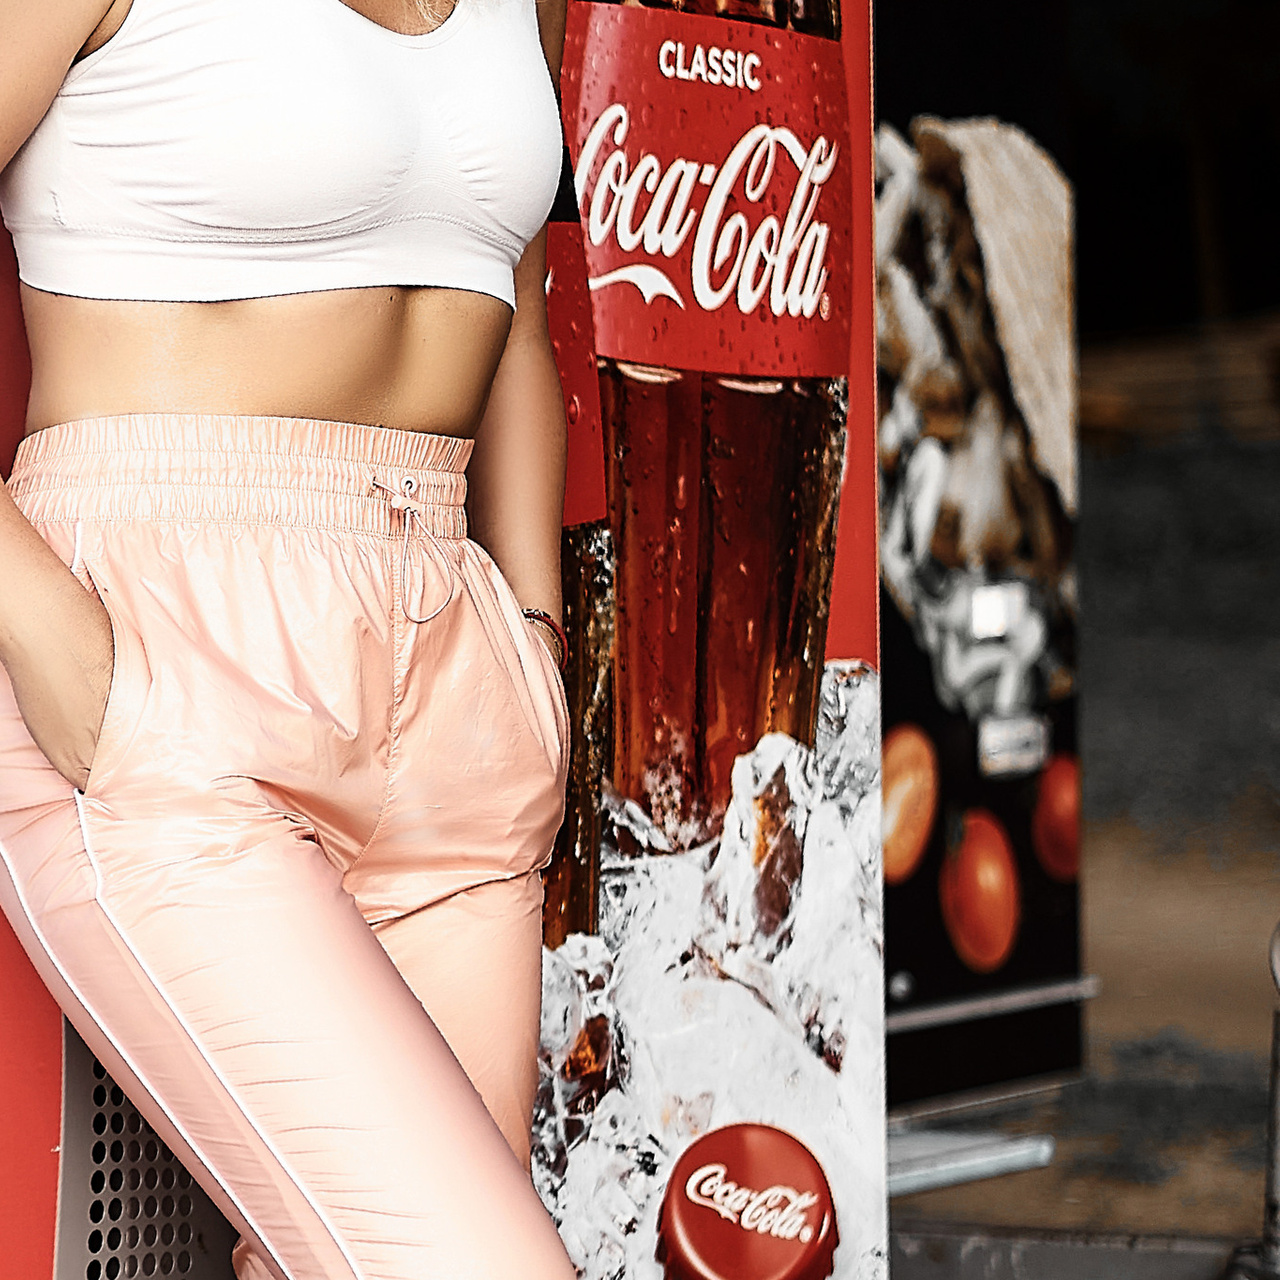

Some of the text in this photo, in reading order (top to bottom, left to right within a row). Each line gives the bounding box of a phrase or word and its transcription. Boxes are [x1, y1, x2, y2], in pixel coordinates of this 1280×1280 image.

[659, 40, 762, 91] CLASSIC
[574, 104, 839, 318] Coca-Cola
[686, 1163, 818, 1241] Coca-Cola
